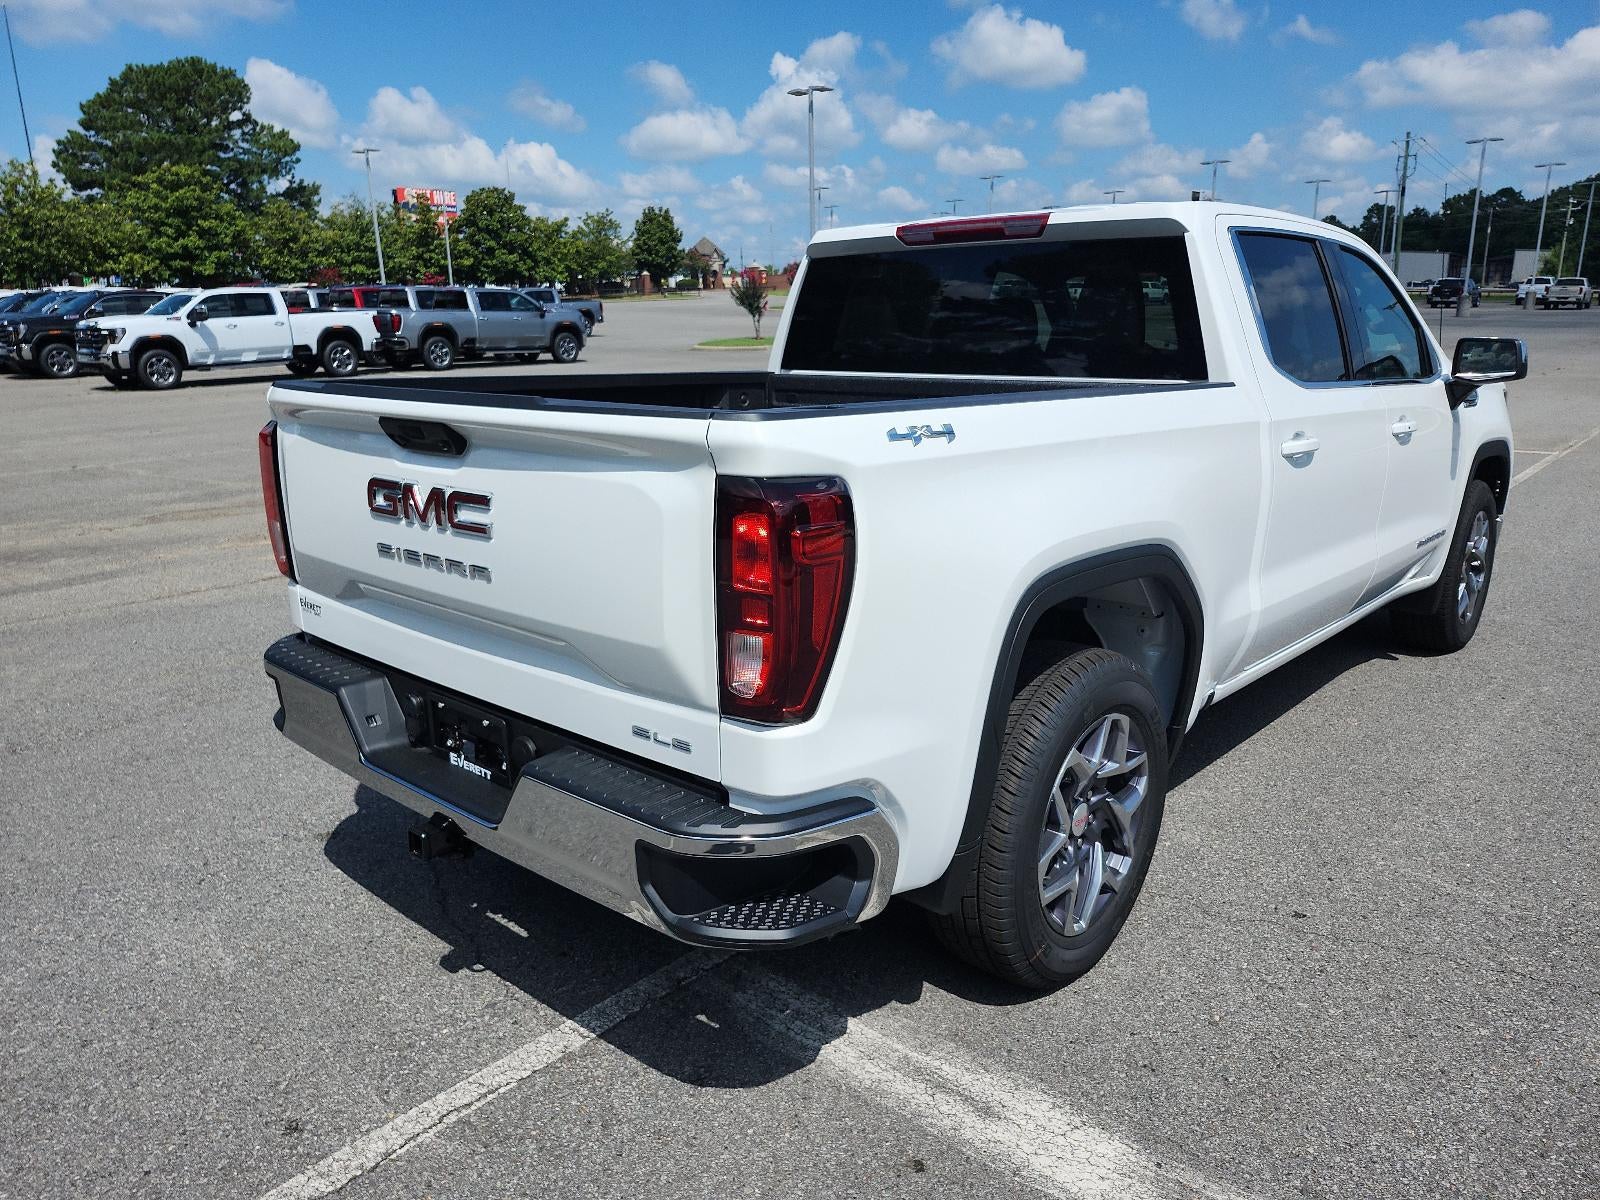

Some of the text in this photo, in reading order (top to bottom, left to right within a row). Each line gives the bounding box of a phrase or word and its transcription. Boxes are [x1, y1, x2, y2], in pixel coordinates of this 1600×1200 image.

[367, 475, 493, 540] GMC
[377, 542, 492, 584] SIERRA
[632, 724, 692, 755] SLE
